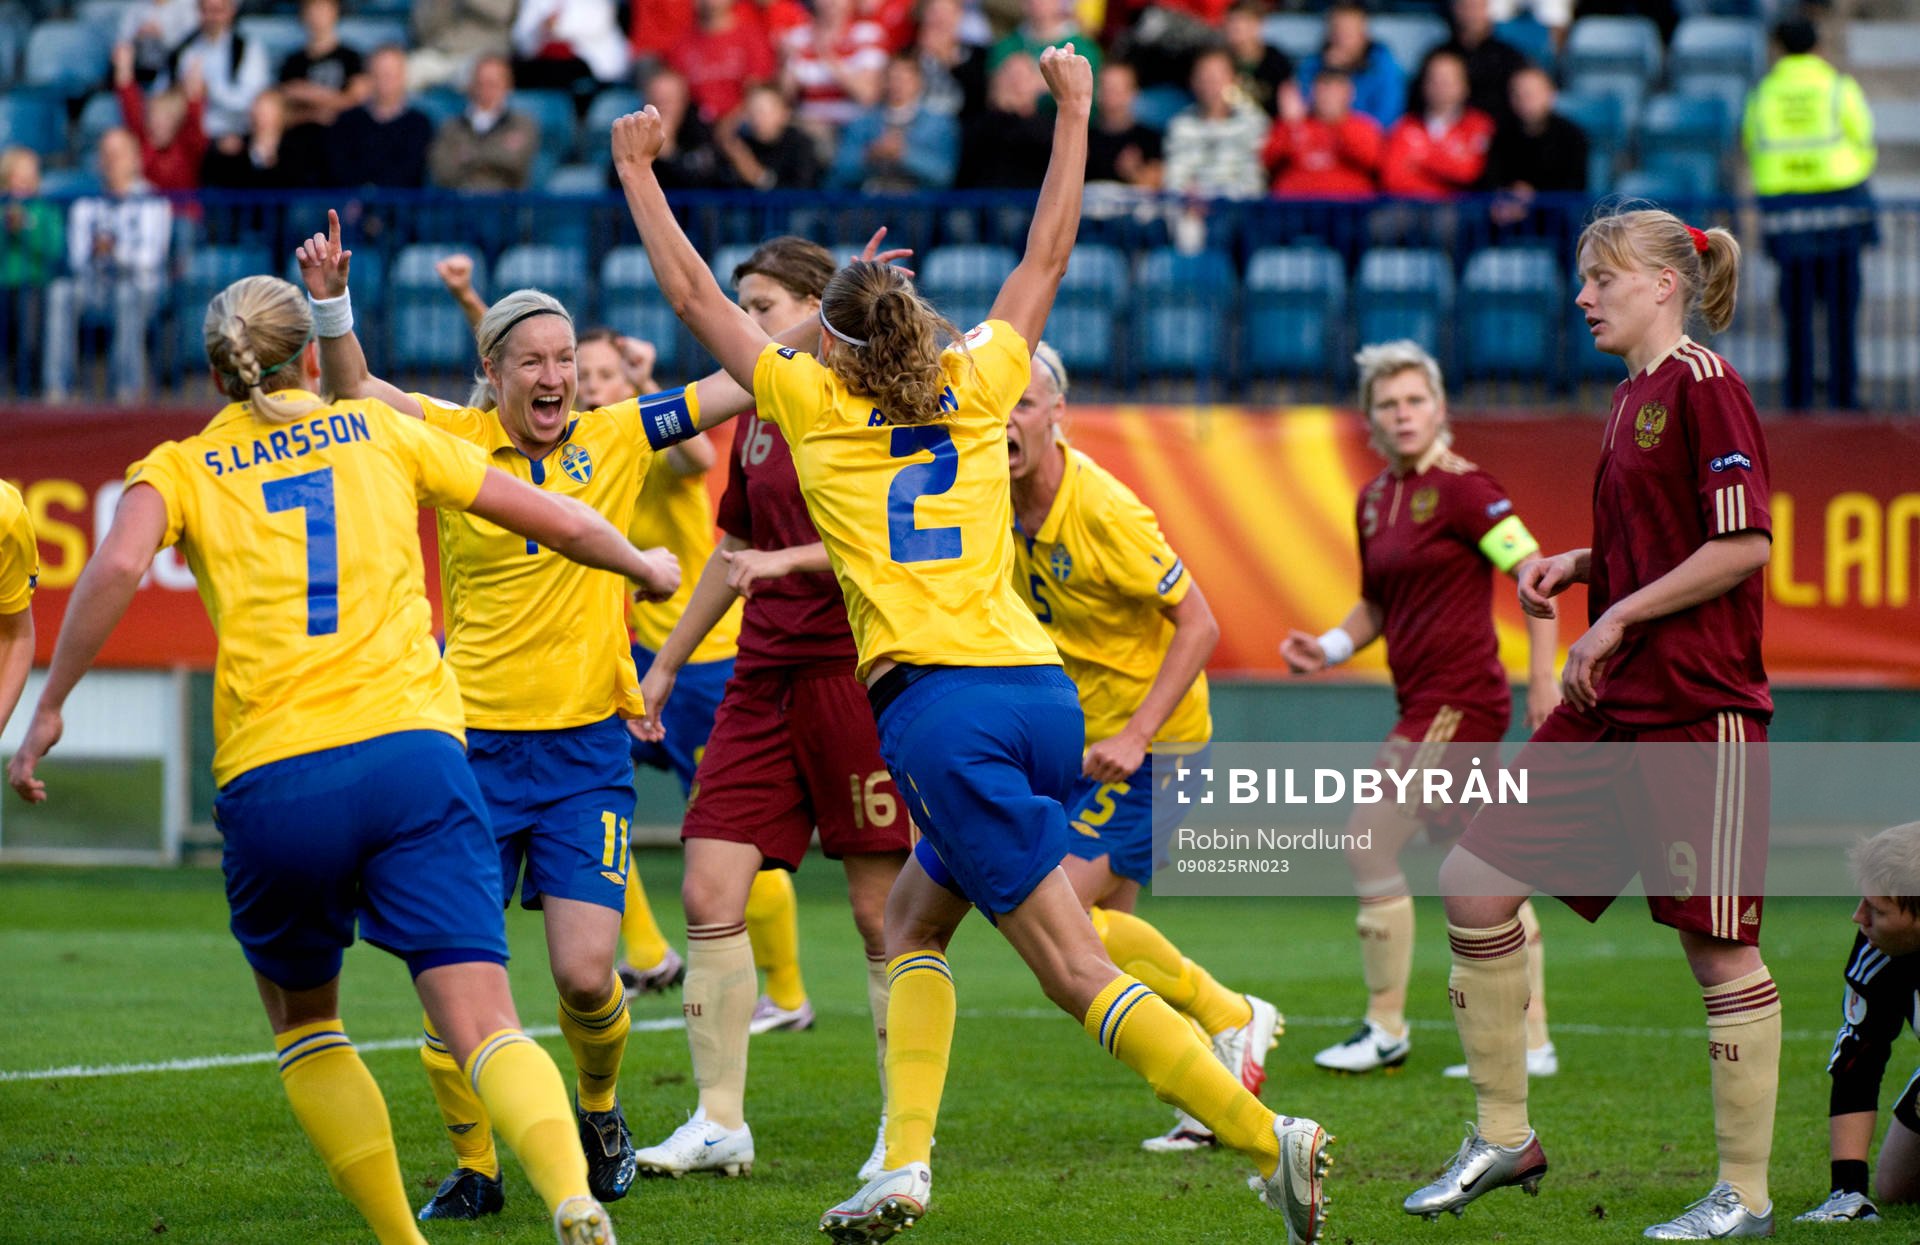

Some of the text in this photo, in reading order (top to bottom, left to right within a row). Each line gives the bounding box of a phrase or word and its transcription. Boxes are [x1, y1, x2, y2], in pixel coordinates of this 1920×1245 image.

[205, 412, 371, 476] S.LARSSON
[741, 414, 774, 468] 16
[887, 424, 963, 564] 2
[262, 466, 338, 637] 7
[850, 769, 897, 829] 16
[1079, 782, 1131, 827] 5
[601, 810, 628, 875] 11
[1668, 840, 1698, 902] 9
